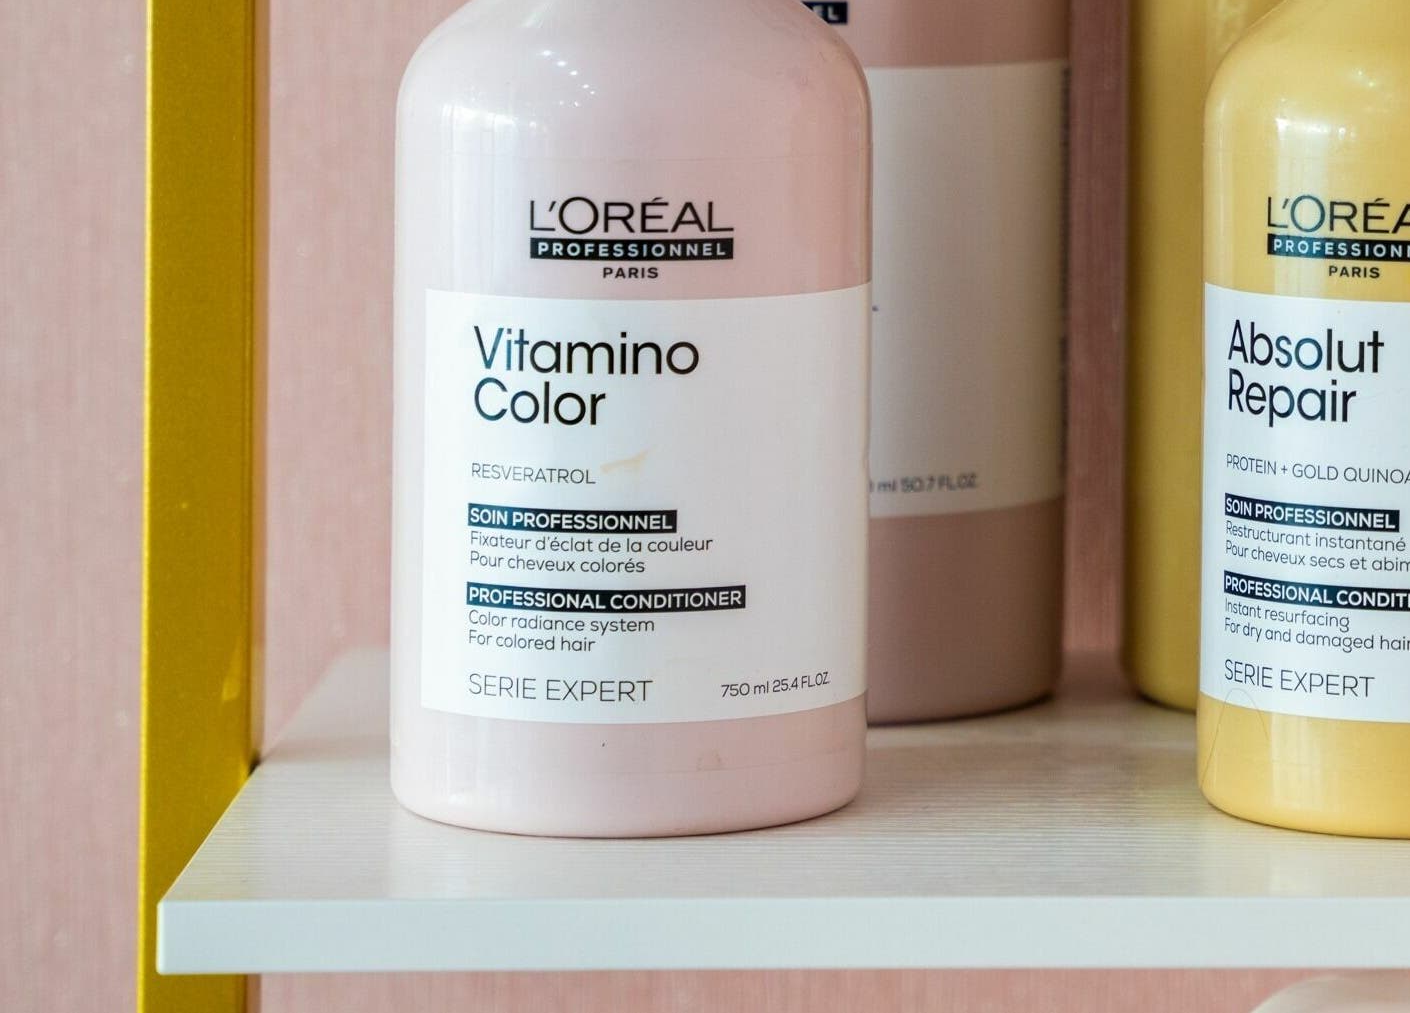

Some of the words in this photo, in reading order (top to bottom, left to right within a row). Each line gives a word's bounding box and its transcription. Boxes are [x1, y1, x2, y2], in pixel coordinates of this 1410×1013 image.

[530, 197, 734, 234] L'ORÉAL
[537, 241, 726, 257] PROFESSIONNEL
[602, 266, 659, 279] PARIS
[1329, 265, 1380, 279] PARIS
[474, 325, 699, 374] Vitamino
[1228, 320, 1385, 373] Absolut
[474, 377, 606, 425] Color
[1228, 368, 1357, 427] Repair
[471, 463, 595, 485] RESVERATROL
[1226, 454, 1277, 476] PROTEIN
[1292, 464, 1339, 481] GOLD
[470, 508, 508, 526] SOIN
[512, 512, 673, 530] PROFESSIONNEL
[1226, 498, 1252, 517] SOIN
[1255, 503, 1395, 529] PROFESSIONNEL
[470, 531, 531, 550] Fixateur
[535, 536, 594, 553] d'éclat
[598, 538, 621, 553] de
[625, 538, 642, 553] la
[647, 536, 713, 552] couleur
[1226, 520, 1311, 547] Restructurant
[1315, 533, 1406, 552] instantané
[470, 552, 504, 569] Pour
[508, 556, 575, 572] cheveux
[580, 557, 645, 573] colorés
[1226, 540, 1248, 558] Pour
[1251, 547, 1306, 567] cheveux
[1310, 556, 1345, 569] secs
[1349, 556, 1367, 571] et
[469, 588, 606, 609] PROFESSIONAL
[610, 590, 742, 609] CONDITIONER
[1225, 576, 1333, 605] PROFESSIONAL
[469, 611, 507, 627] Color
[511, 616, 585, 632] radiance
[590, 617, 655, 635] system
[1225, 599, 1262, 618] Instant
[1265, 607, 1350, 633] resurfacing
[469, 631, 492, 647] For
[496, 633, 555, 650] colored
[561, 636, 595, 651] hair
[1225, 619, 1240, 634] For
[1243, 622, 1262, 642] dry
[1265, 626, 1291, 643] and
[1296, 629, 1374, 653] damaged
[469, 673, 537, 699] SERIE
[546, 679, 653, 701] EXPERT
[721, 683, 749, 697] 750
[754, 681, 768, 694] ml
[773, 677, 798, 692] 25.4
[1225, 659, 1273, 689] SERIE
[1281, 669, 1374, 698] EXPERT
